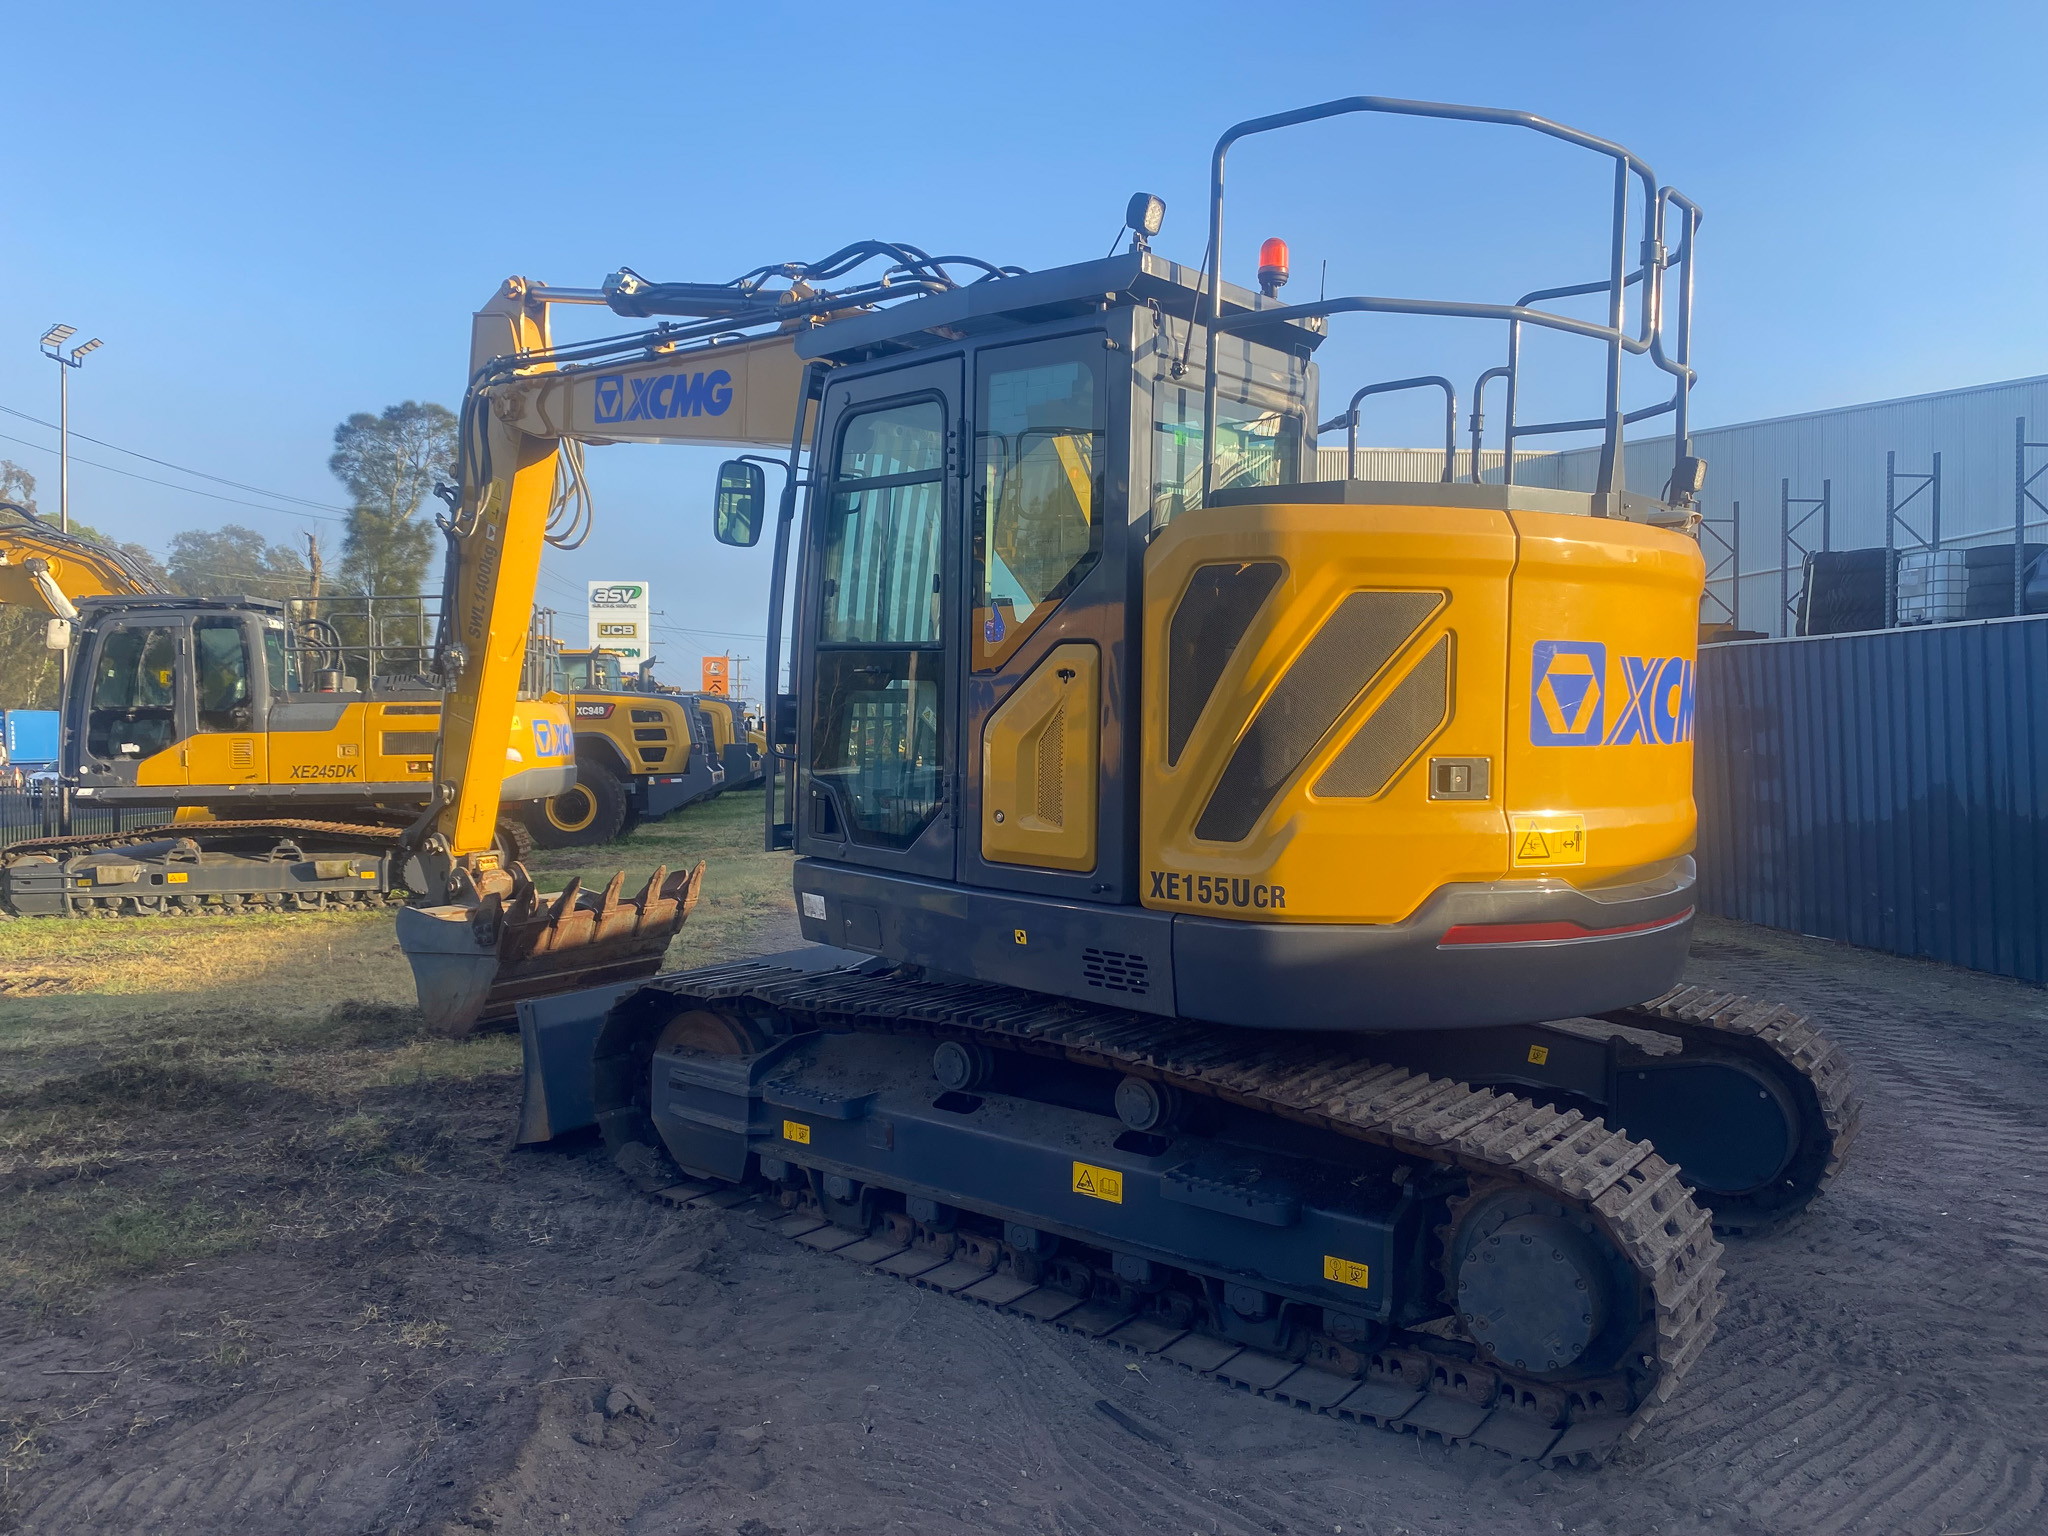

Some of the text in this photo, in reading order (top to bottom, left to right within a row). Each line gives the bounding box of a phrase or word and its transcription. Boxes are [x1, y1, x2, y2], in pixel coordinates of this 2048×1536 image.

[623, 369, 733, 421] XCMG
[468, 545, 498, 639] SWL 1400kg
[601, 625, 635, 635] JCB
[290, 764, 358, 779] XE245DK
[1149, 870, 1286, 908] XE155UCR
